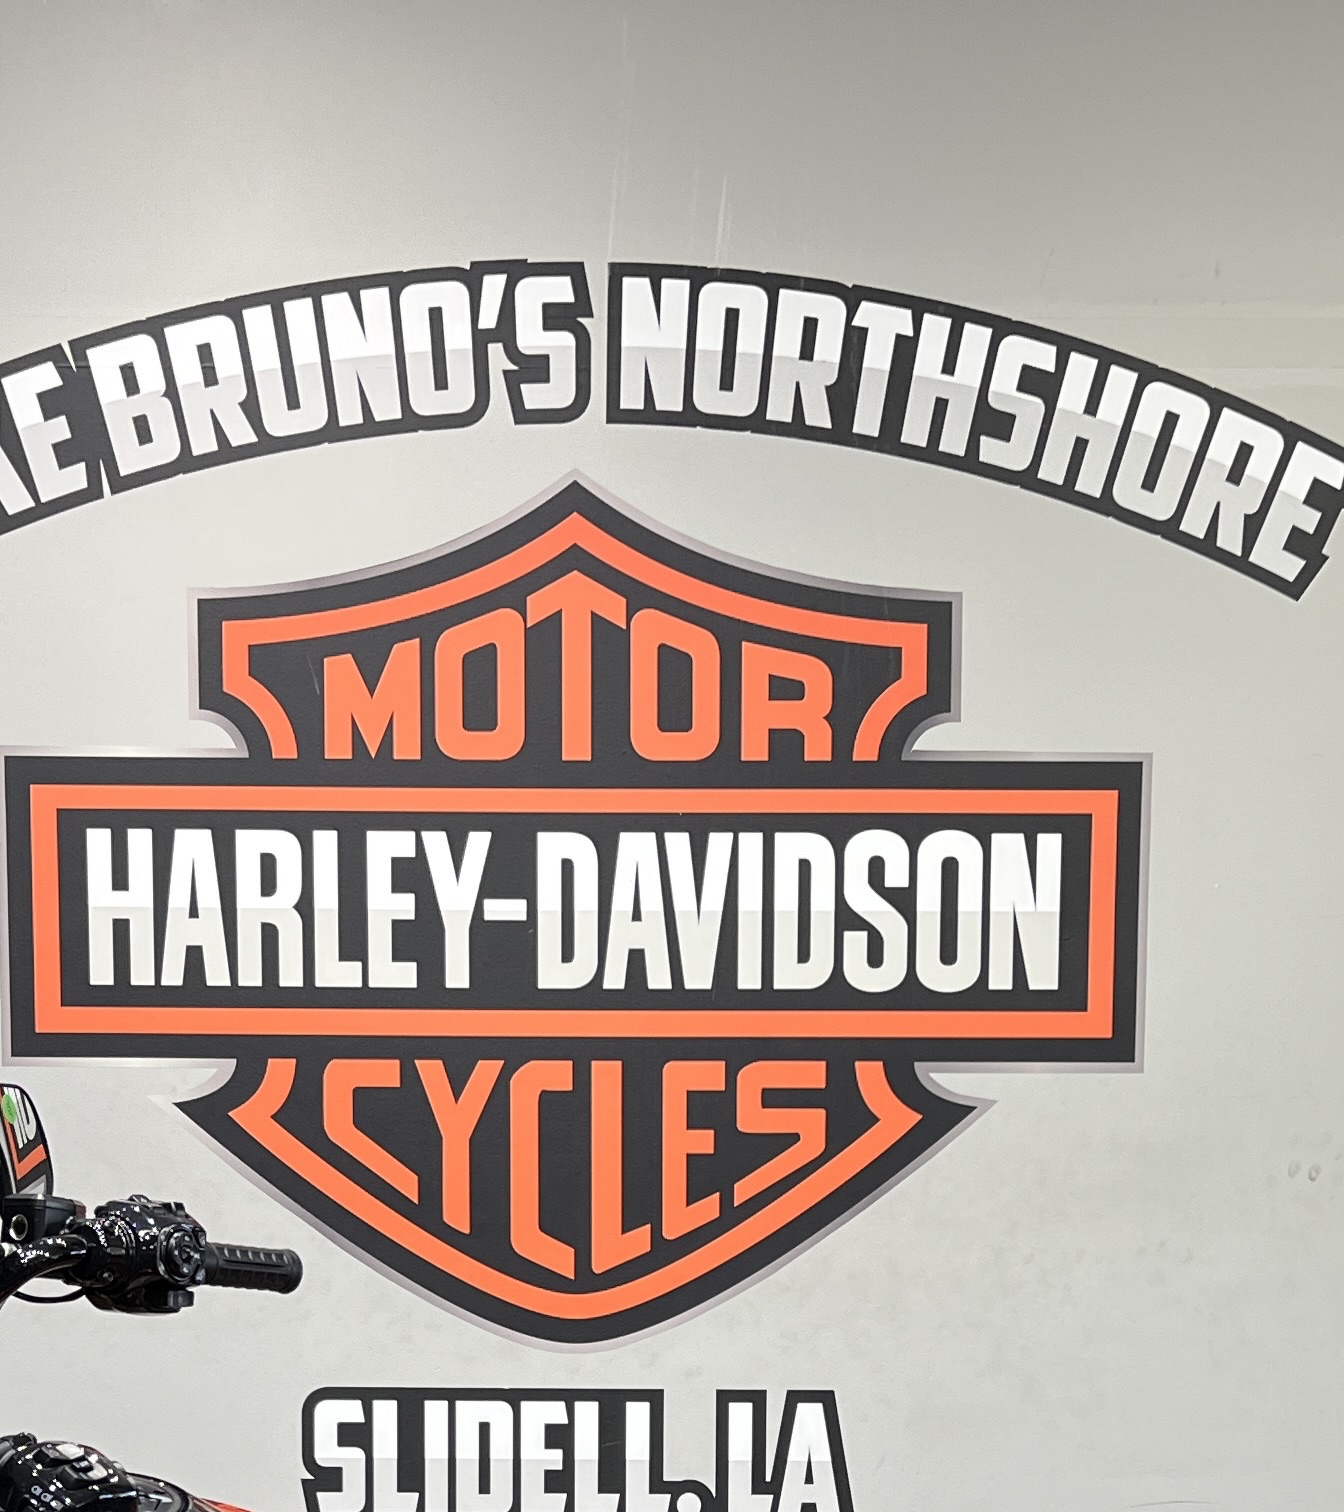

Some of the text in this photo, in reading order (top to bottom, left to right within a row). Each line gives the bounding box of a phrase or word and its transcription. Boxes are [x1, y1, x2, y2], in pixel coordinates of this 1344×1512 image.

[86, 273, 576, 477] BRUNO'S
[323, 568, 834, 763] MOTOR
[84, 828, 1064, 992] HARLEY-DAVIDSON
[321, 1058, 829, 1280] CYCLES
